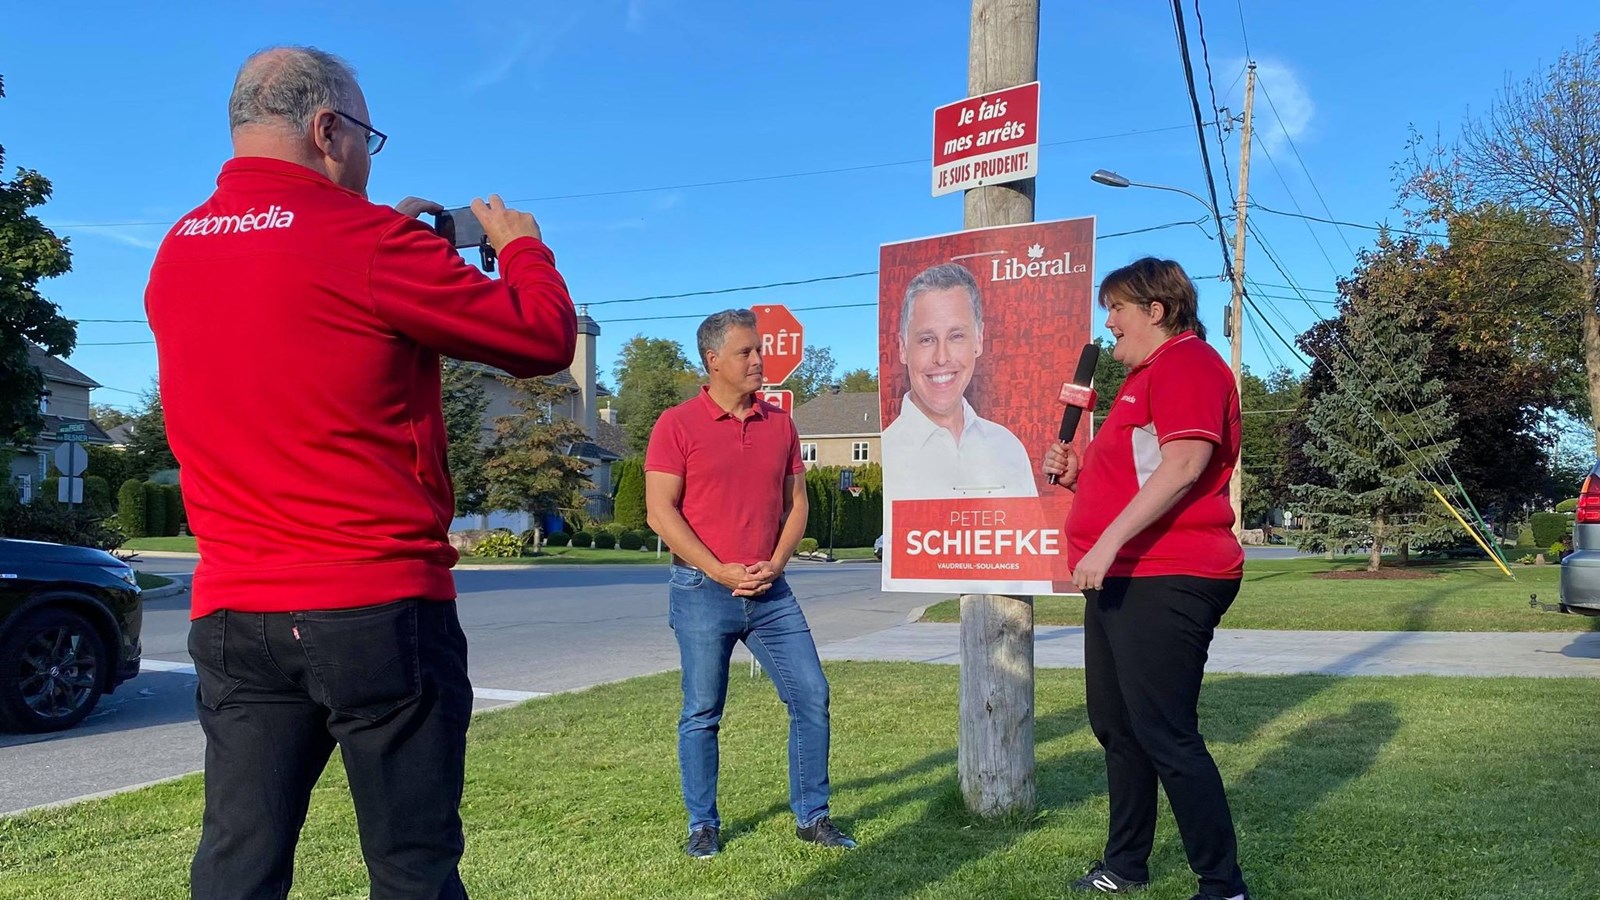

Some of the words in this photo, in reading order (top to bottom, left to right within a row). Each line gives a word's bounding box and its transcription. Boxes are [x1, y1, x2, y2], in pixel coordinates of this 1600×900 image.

[957, 107, 975, 128] Je
[978, 98, 1008, 122] fais
[943, 134, 973, 156] mes
[976, 121, 1026, 147] arrêts
[938, 170, 948, 189] JE
[950, 163, 971, 186] SUIS
[973, 151, 1029, 180] PRUDENT!
[175, 204, 295, 236] néomédia
[762, 328, 801, 356] RÊT
[950, 510, 1006, 527] PETER
[906, 529, 1060, 556] SCHIEFKE
[937, 561, 1020, 571] VAUDREUIL-SOULANGES
